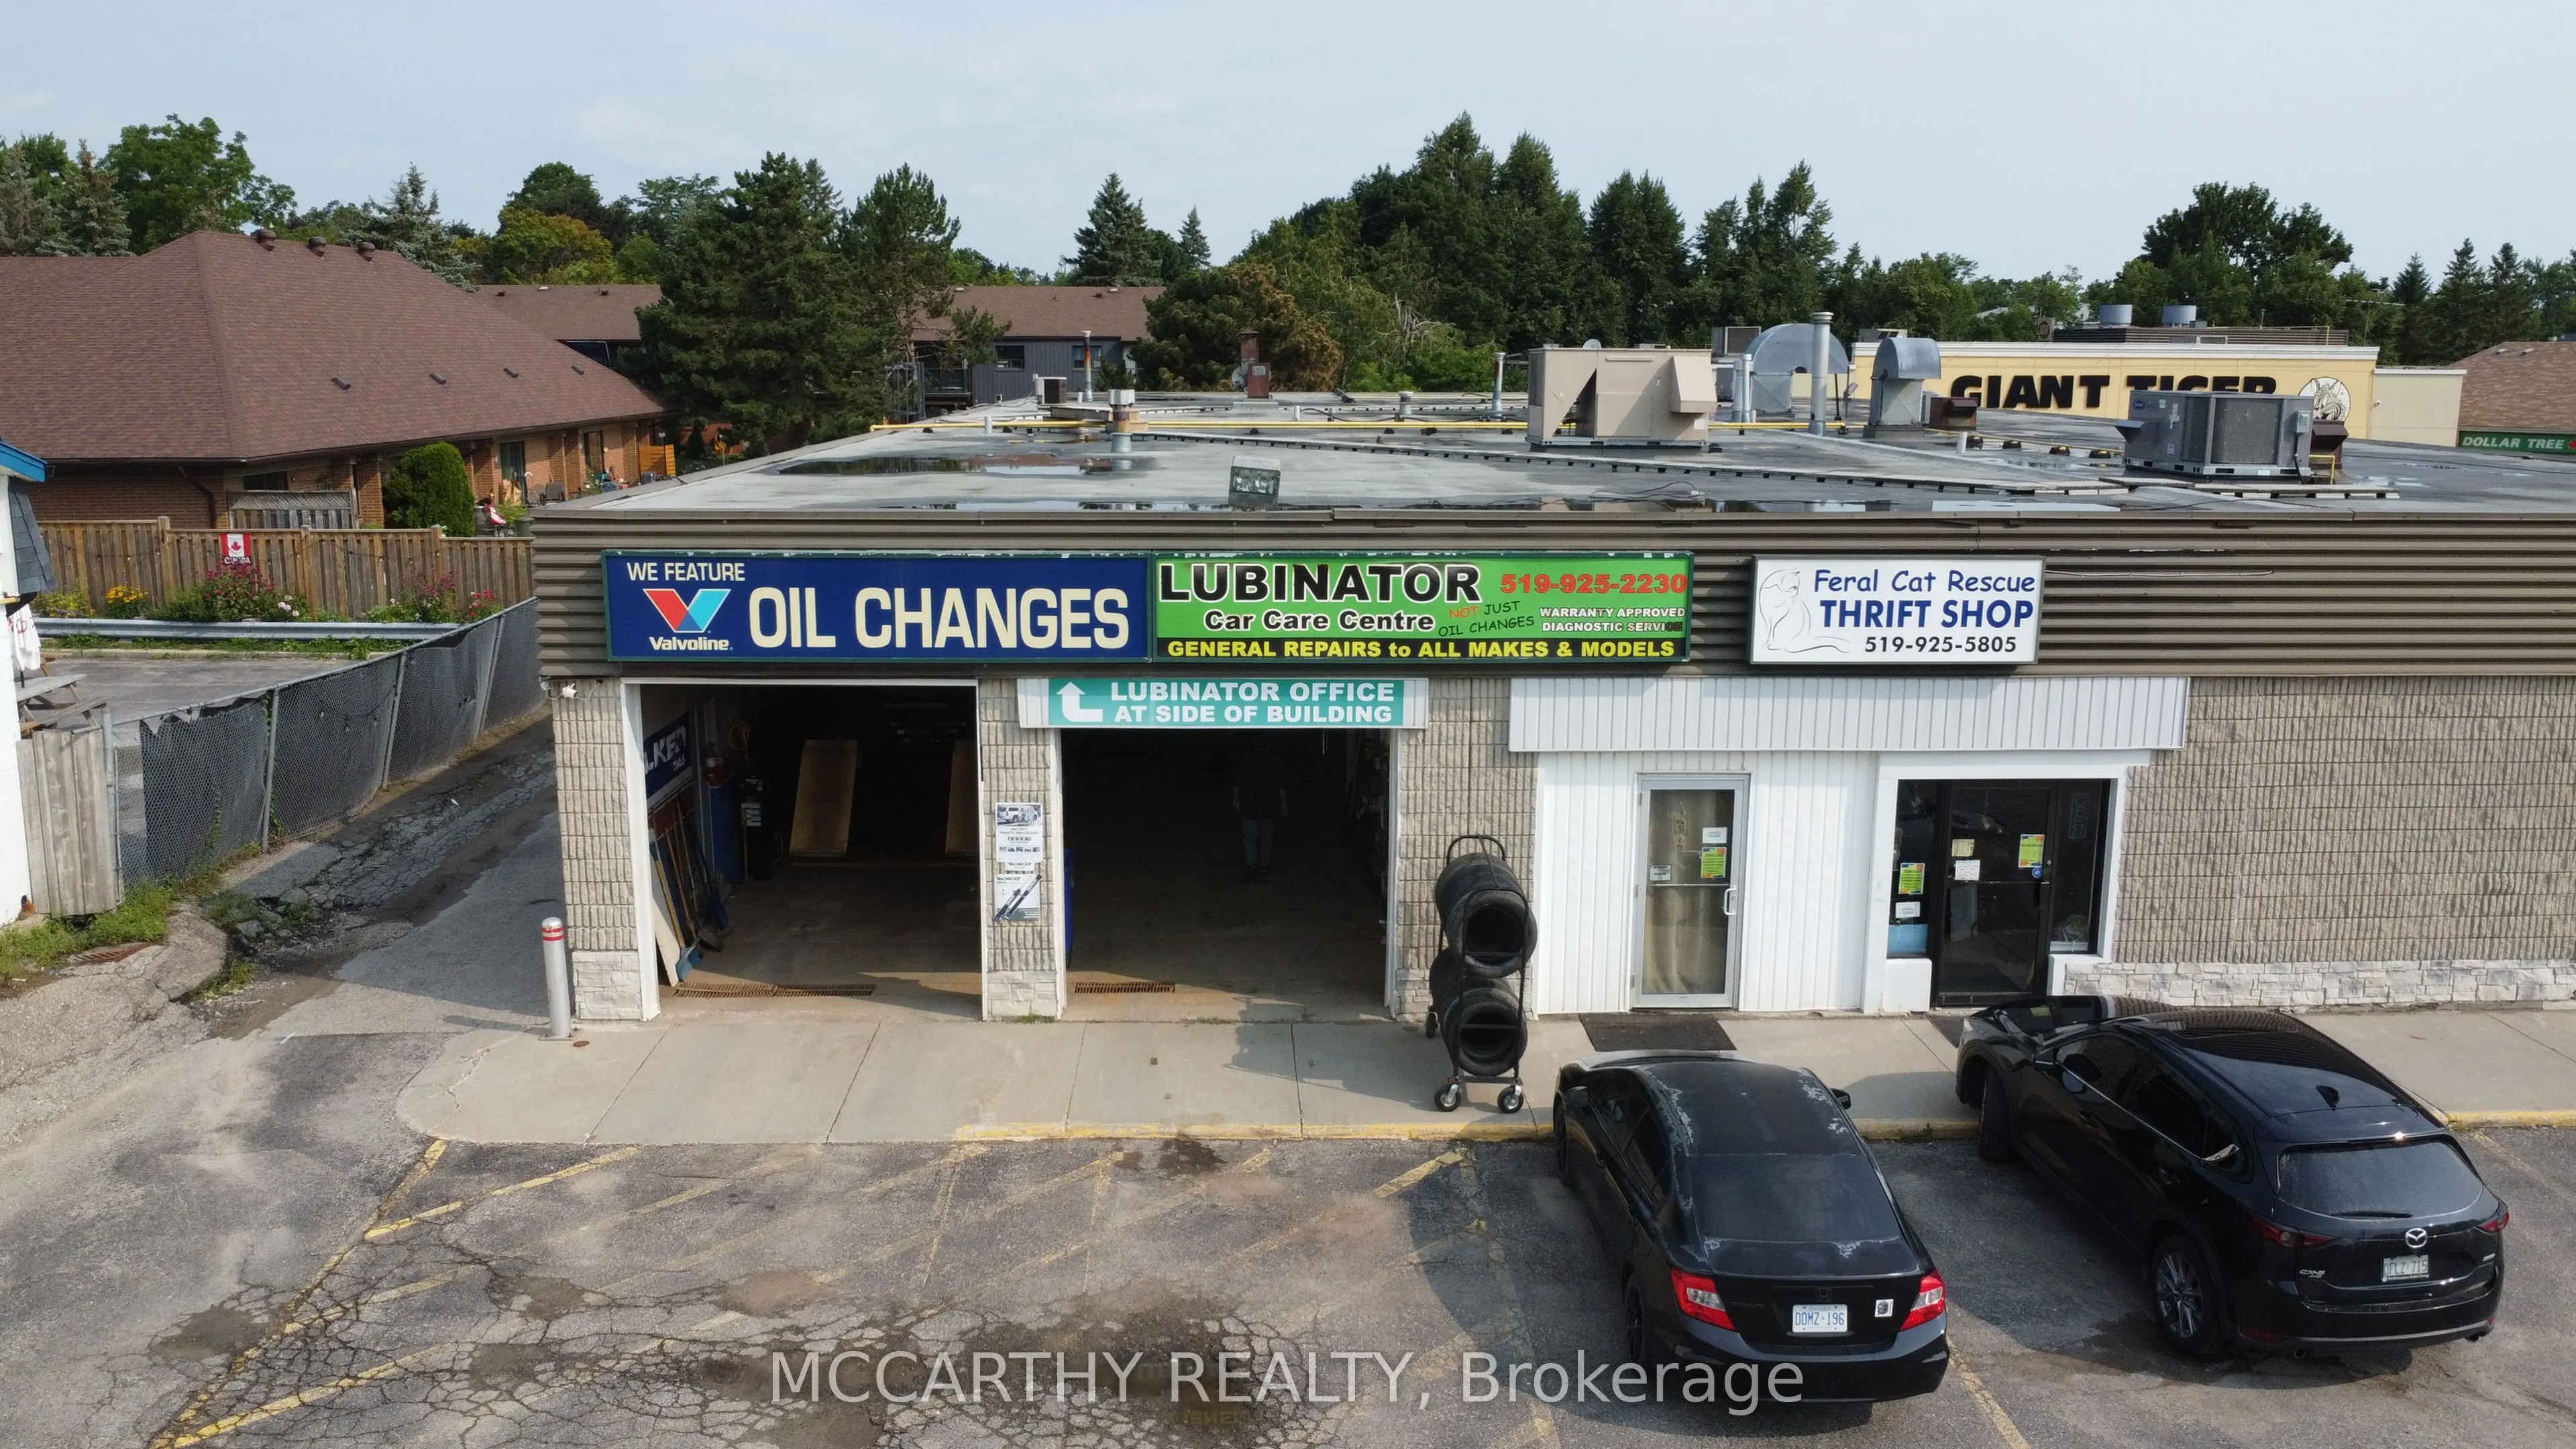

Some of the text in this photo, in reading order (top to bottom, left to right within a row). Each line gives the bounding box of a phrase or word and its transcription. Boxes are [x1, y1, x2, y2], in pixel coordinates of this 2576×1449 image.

[1951, 374, 2110, 409] GIANT
[2462, 436, 2565, 449] DOLLAR TREE
[627, 562, 746, 581] WE FEATURE
[1814, 569, 2035, 593] Feral Cat Rescue
[1159, 563, 1481, 603] LUBINATOR
[1500, 574, 1686, 594] 519-925-2230
[749, 586, 1129, 649] OIL CHANGES
[1448, 600, 1520, 619] NOT JUST
[1539, 608, 1686, 618] WARRANTY APPROVED
[1819, 599, 2034, 629] THRIFT SHOP
[1204, 609, 1434, 632] Car Care Centre
[1438, 616, 1535, 637] OIL CHANGES
[1542, 621, 1683, 632] DIAGNOSTIC SERVICE
[649, 637, 729, 651] Valvoline
[1167, 641, 1675, 657] GENERAL REPAIRS to ALL MAKES & MODELS
[1864, 636, 2017, 653] 519-925-5805
[1110, 682, 1395, 702] LUBINATOR OFFICE
[1114, 706, 1392, 723] AT SIDE OF BUILDING
[1795, 1312, 1845, 1326] DDMZ 196
